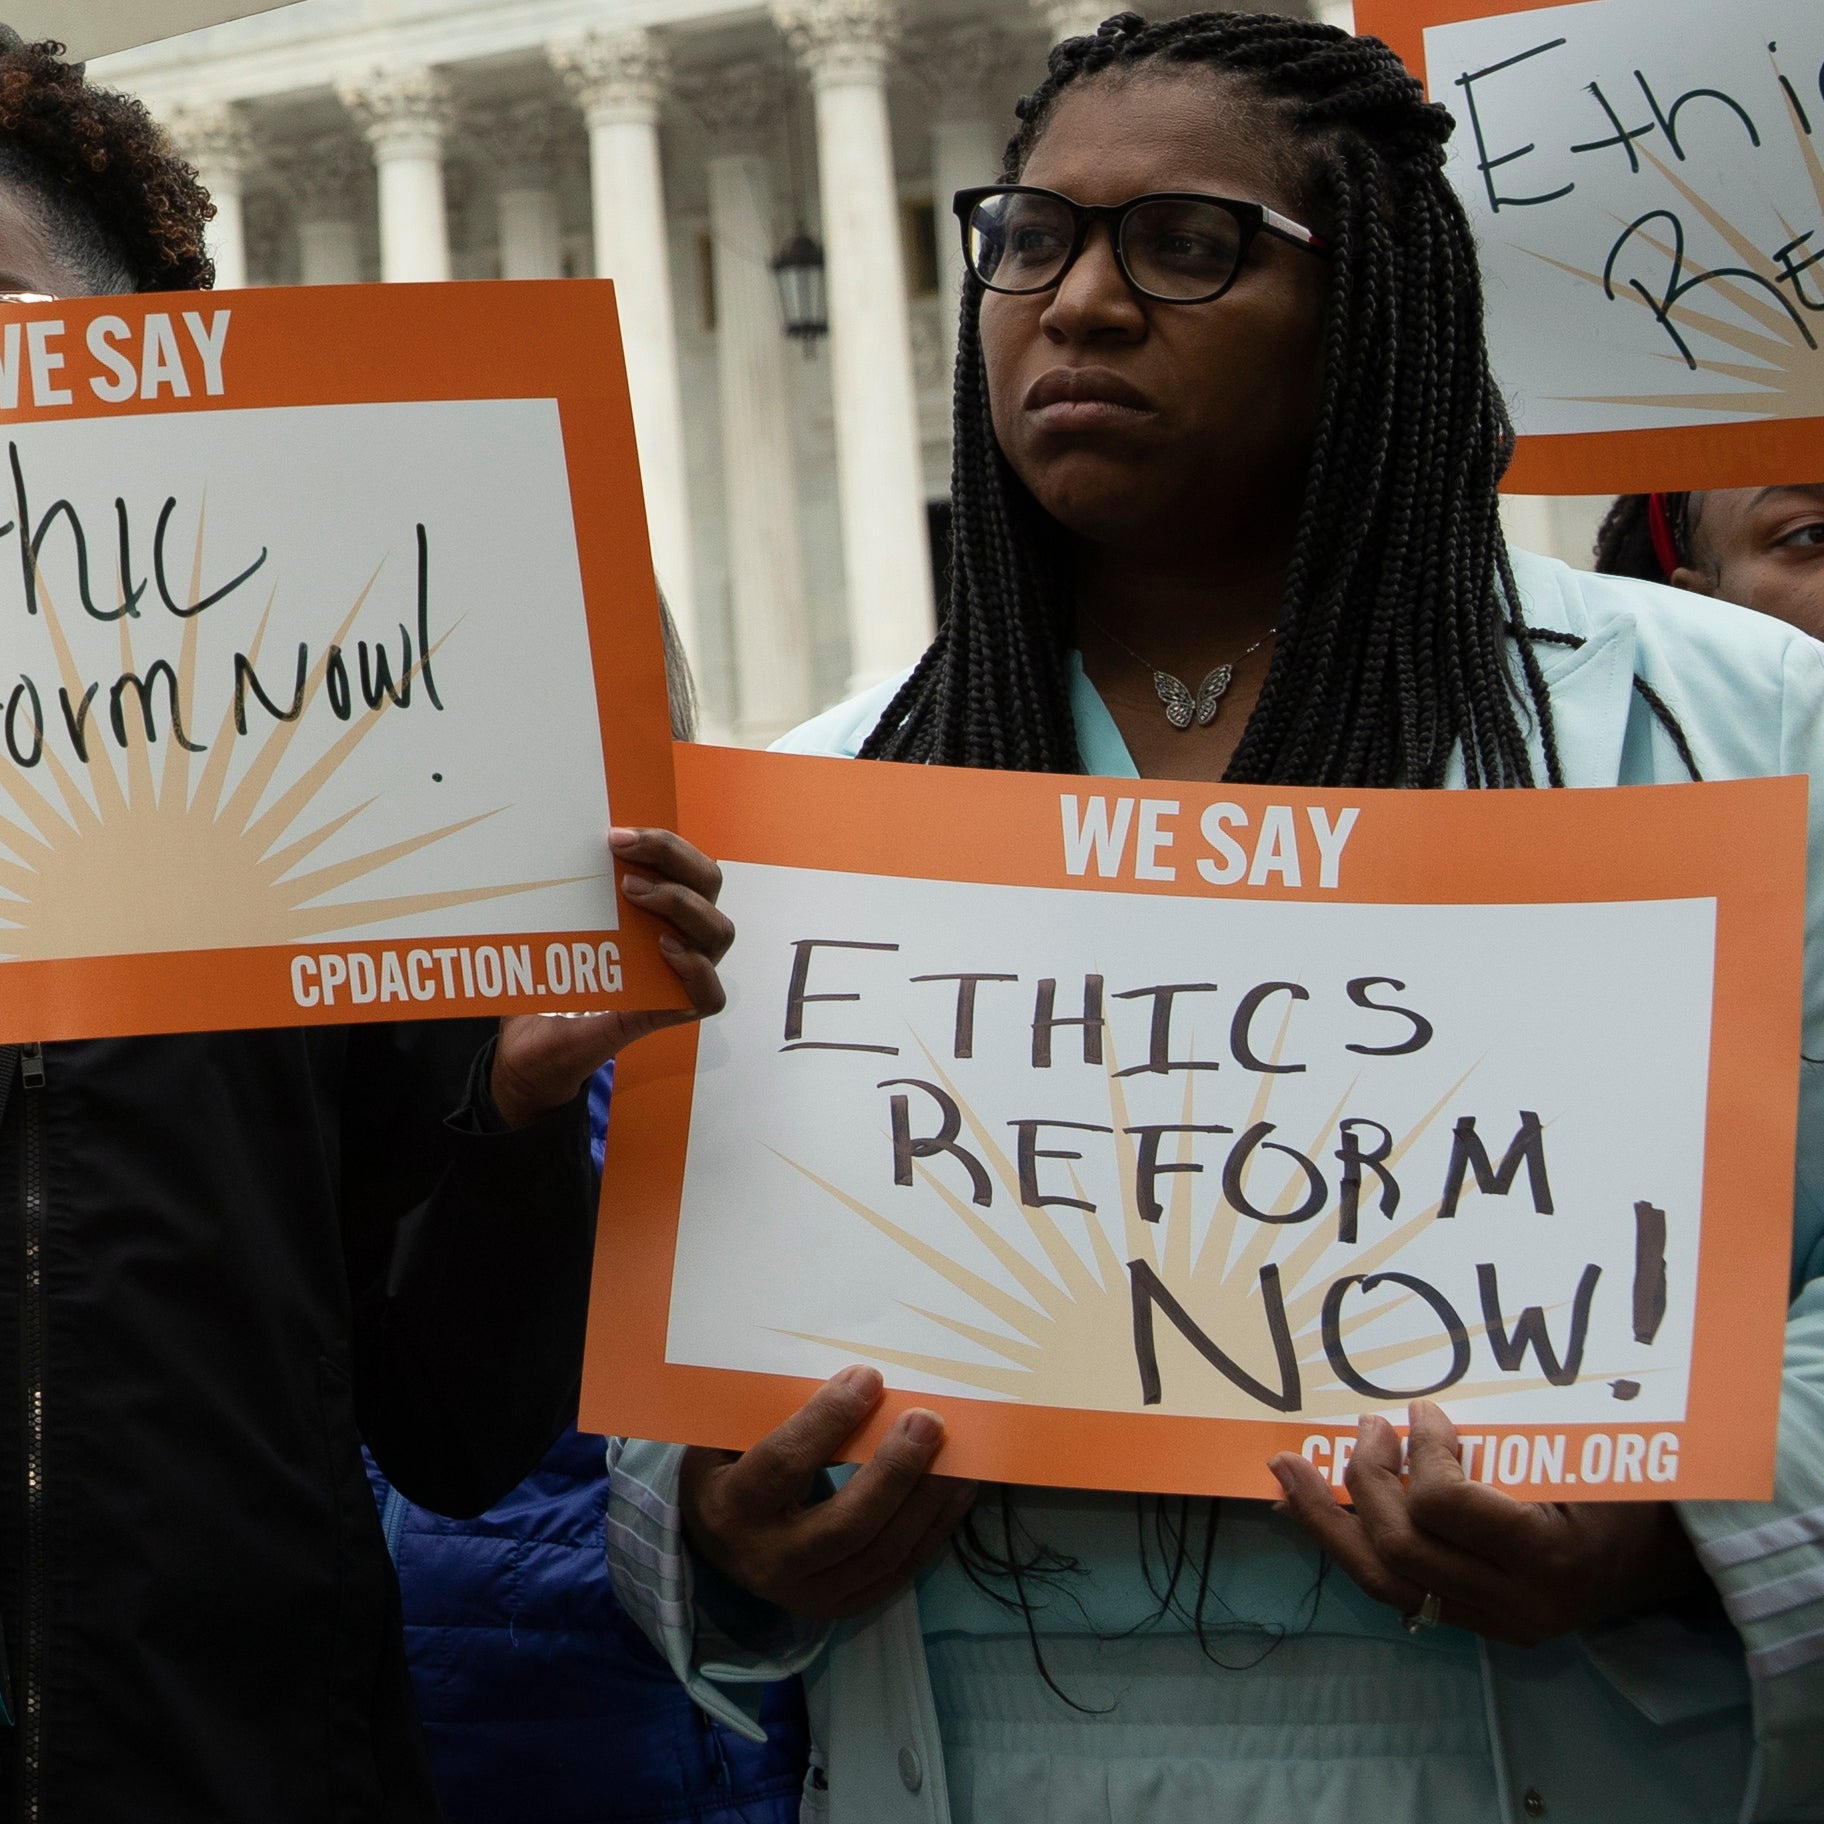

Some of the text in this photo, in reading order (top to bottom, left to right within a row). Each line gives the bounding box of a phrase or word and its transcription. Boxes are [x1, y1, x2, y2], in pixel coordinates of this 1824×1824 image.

[1455, 38, 1824, 213] Ethi
[88, 309, 231, 404] SAY
[1060, 793, 1361, 890] WE SAY
[290, 940, 624, 1009] CPDACTION.ORG
[778, 938, 1433, 1078] ETHICS
[877, 1078, 1553, 1244] REFORM
[1126, 1200, 1668, 1414] NOW!
[1301, 1432, 1679, 1487] CPTION.ORG
